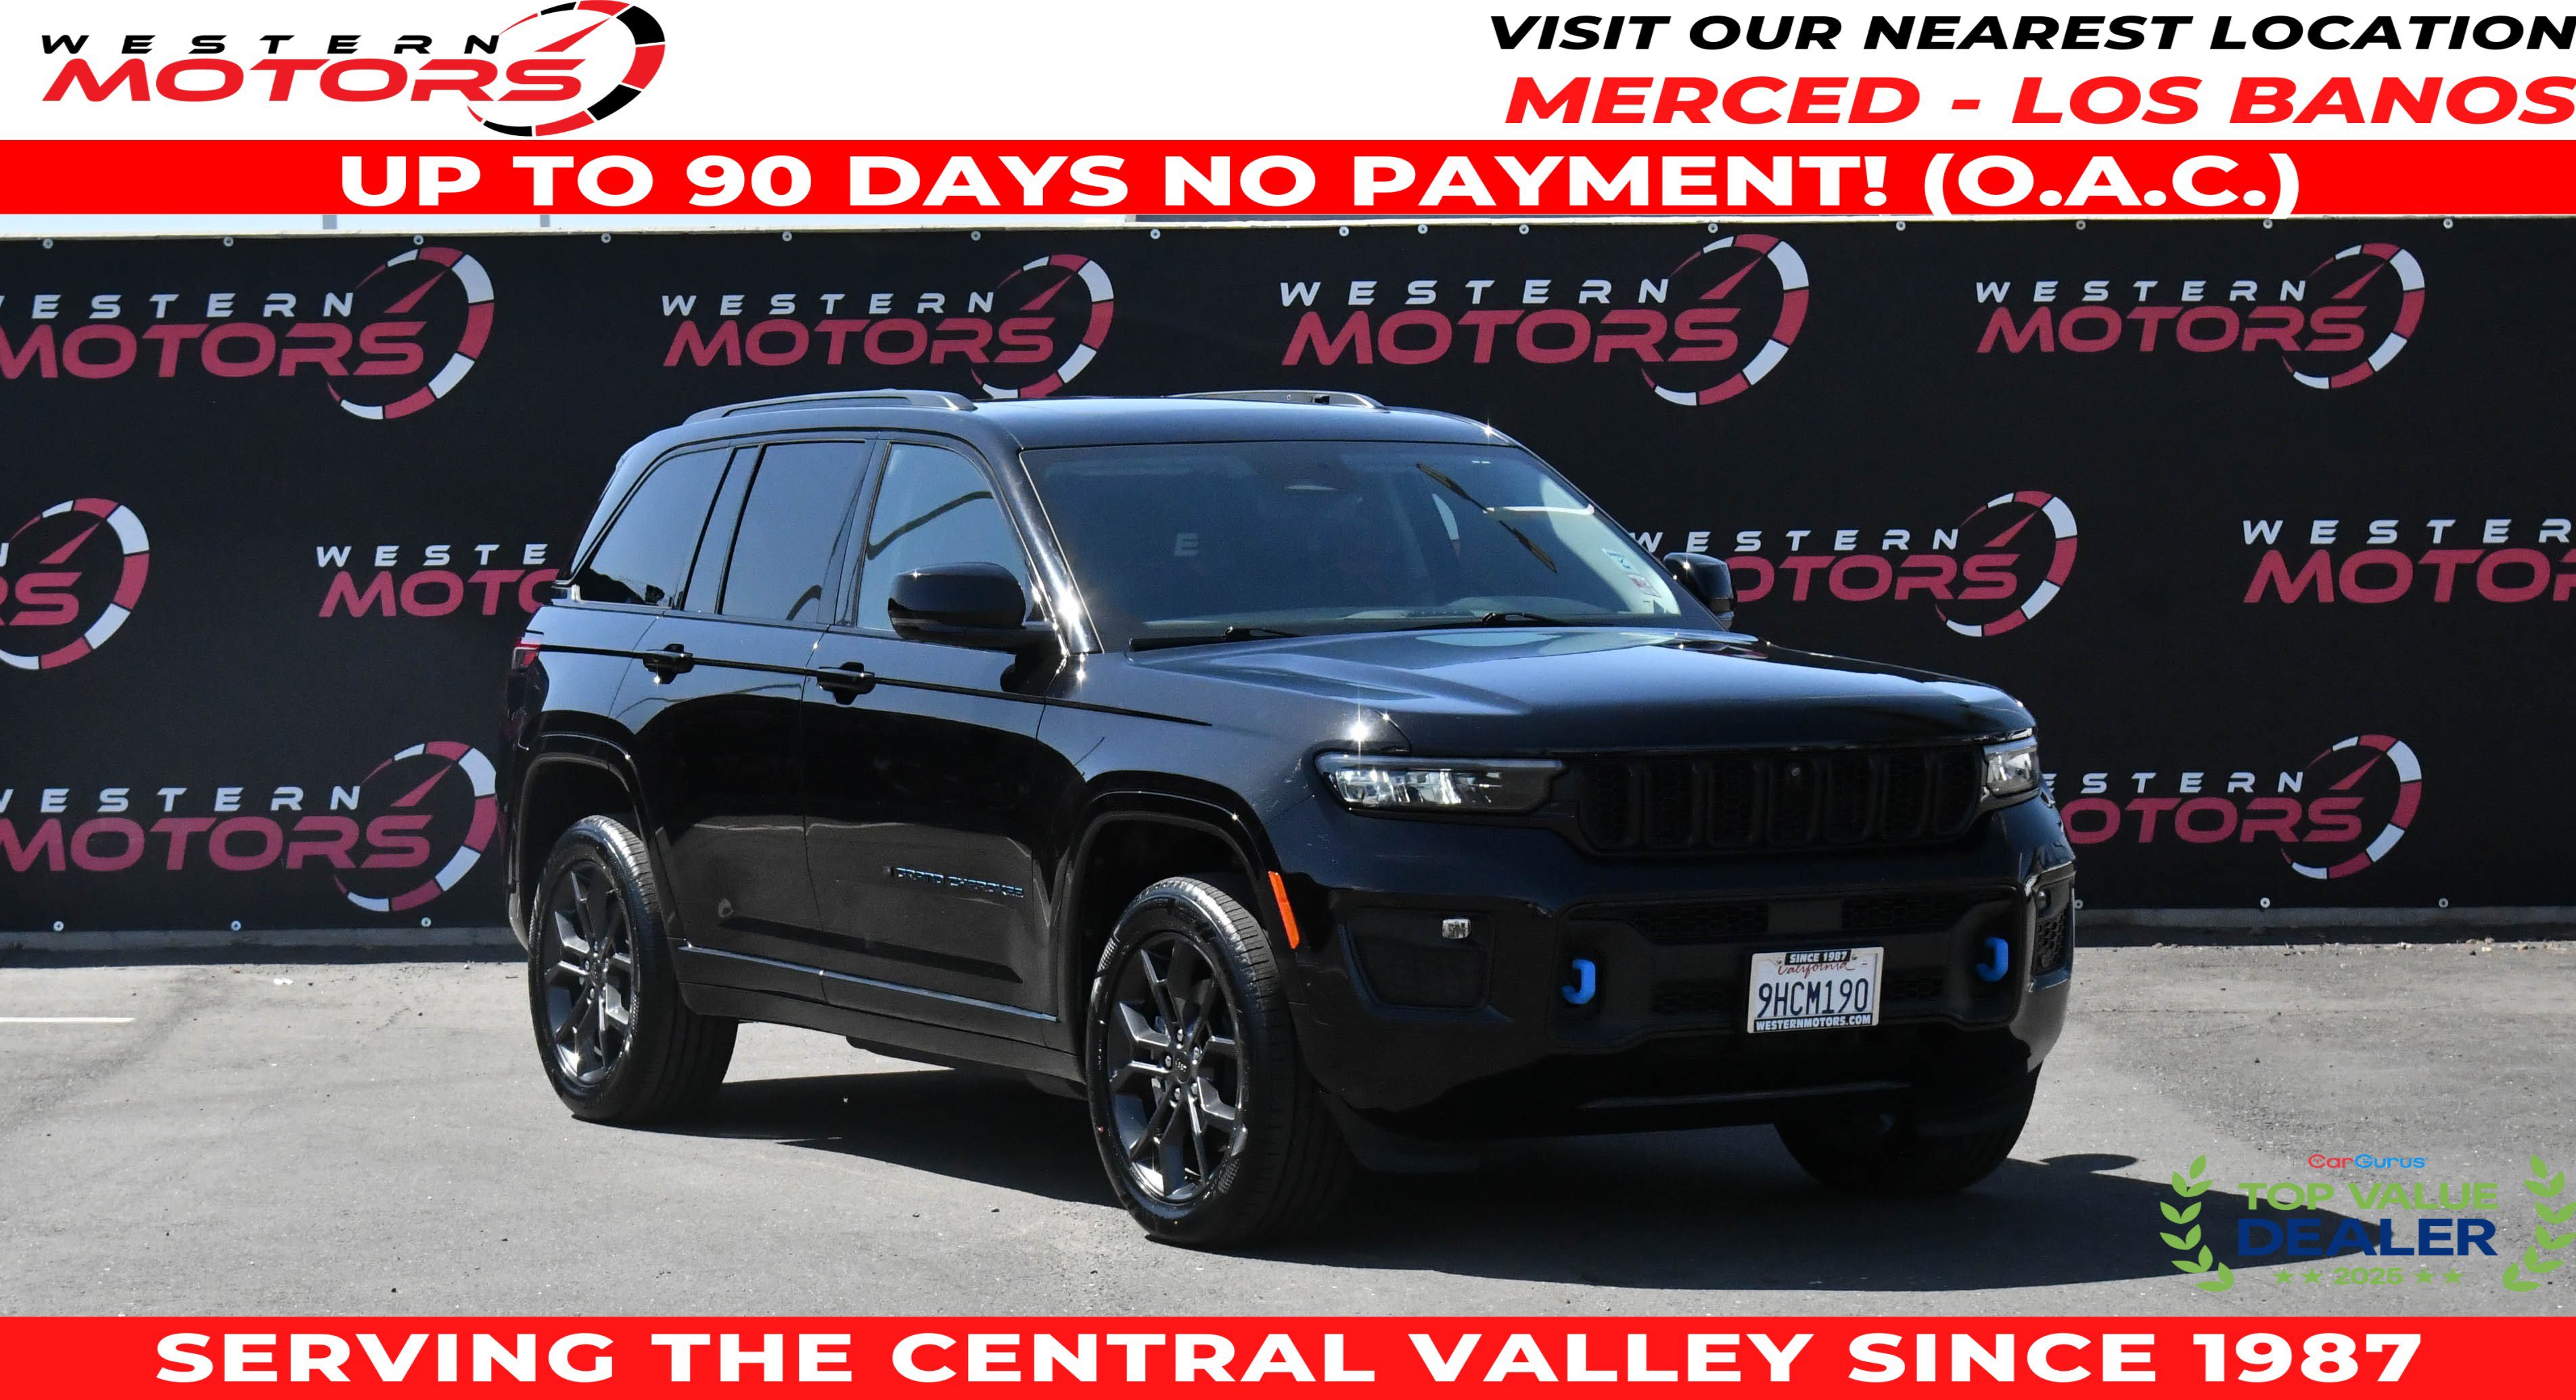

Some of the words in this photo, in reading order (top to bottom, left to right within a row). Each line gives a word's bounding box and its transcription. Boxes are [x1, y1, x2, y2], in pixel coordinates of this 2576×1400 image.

[0, 293, 353, 319] ESTERN
[662, 292, 994, 317] WESTERN
[1280, 279, 1669, 307] WESTERN
[1976, 281, 2305, 303] WESTERN
[664, 318, 1055, 367] MOTORS
[1282, 308, 1741, 365] MOTORS
[1977, 306, 2367, 353] MOTORS
[0, 322, 426, 379] MOTORS
[2243, 519, 2572, 544] WESTER
[0, 815, 432, 872] MOTORS
[1789, 952, 1820, 964] SINCE
[1823, 951, 1847, 962] 1987
[1757, 978, 1869, 1018] 9HCM190
[1755, 1014, 1871, 1031] WESTERNMOTORS.COM
